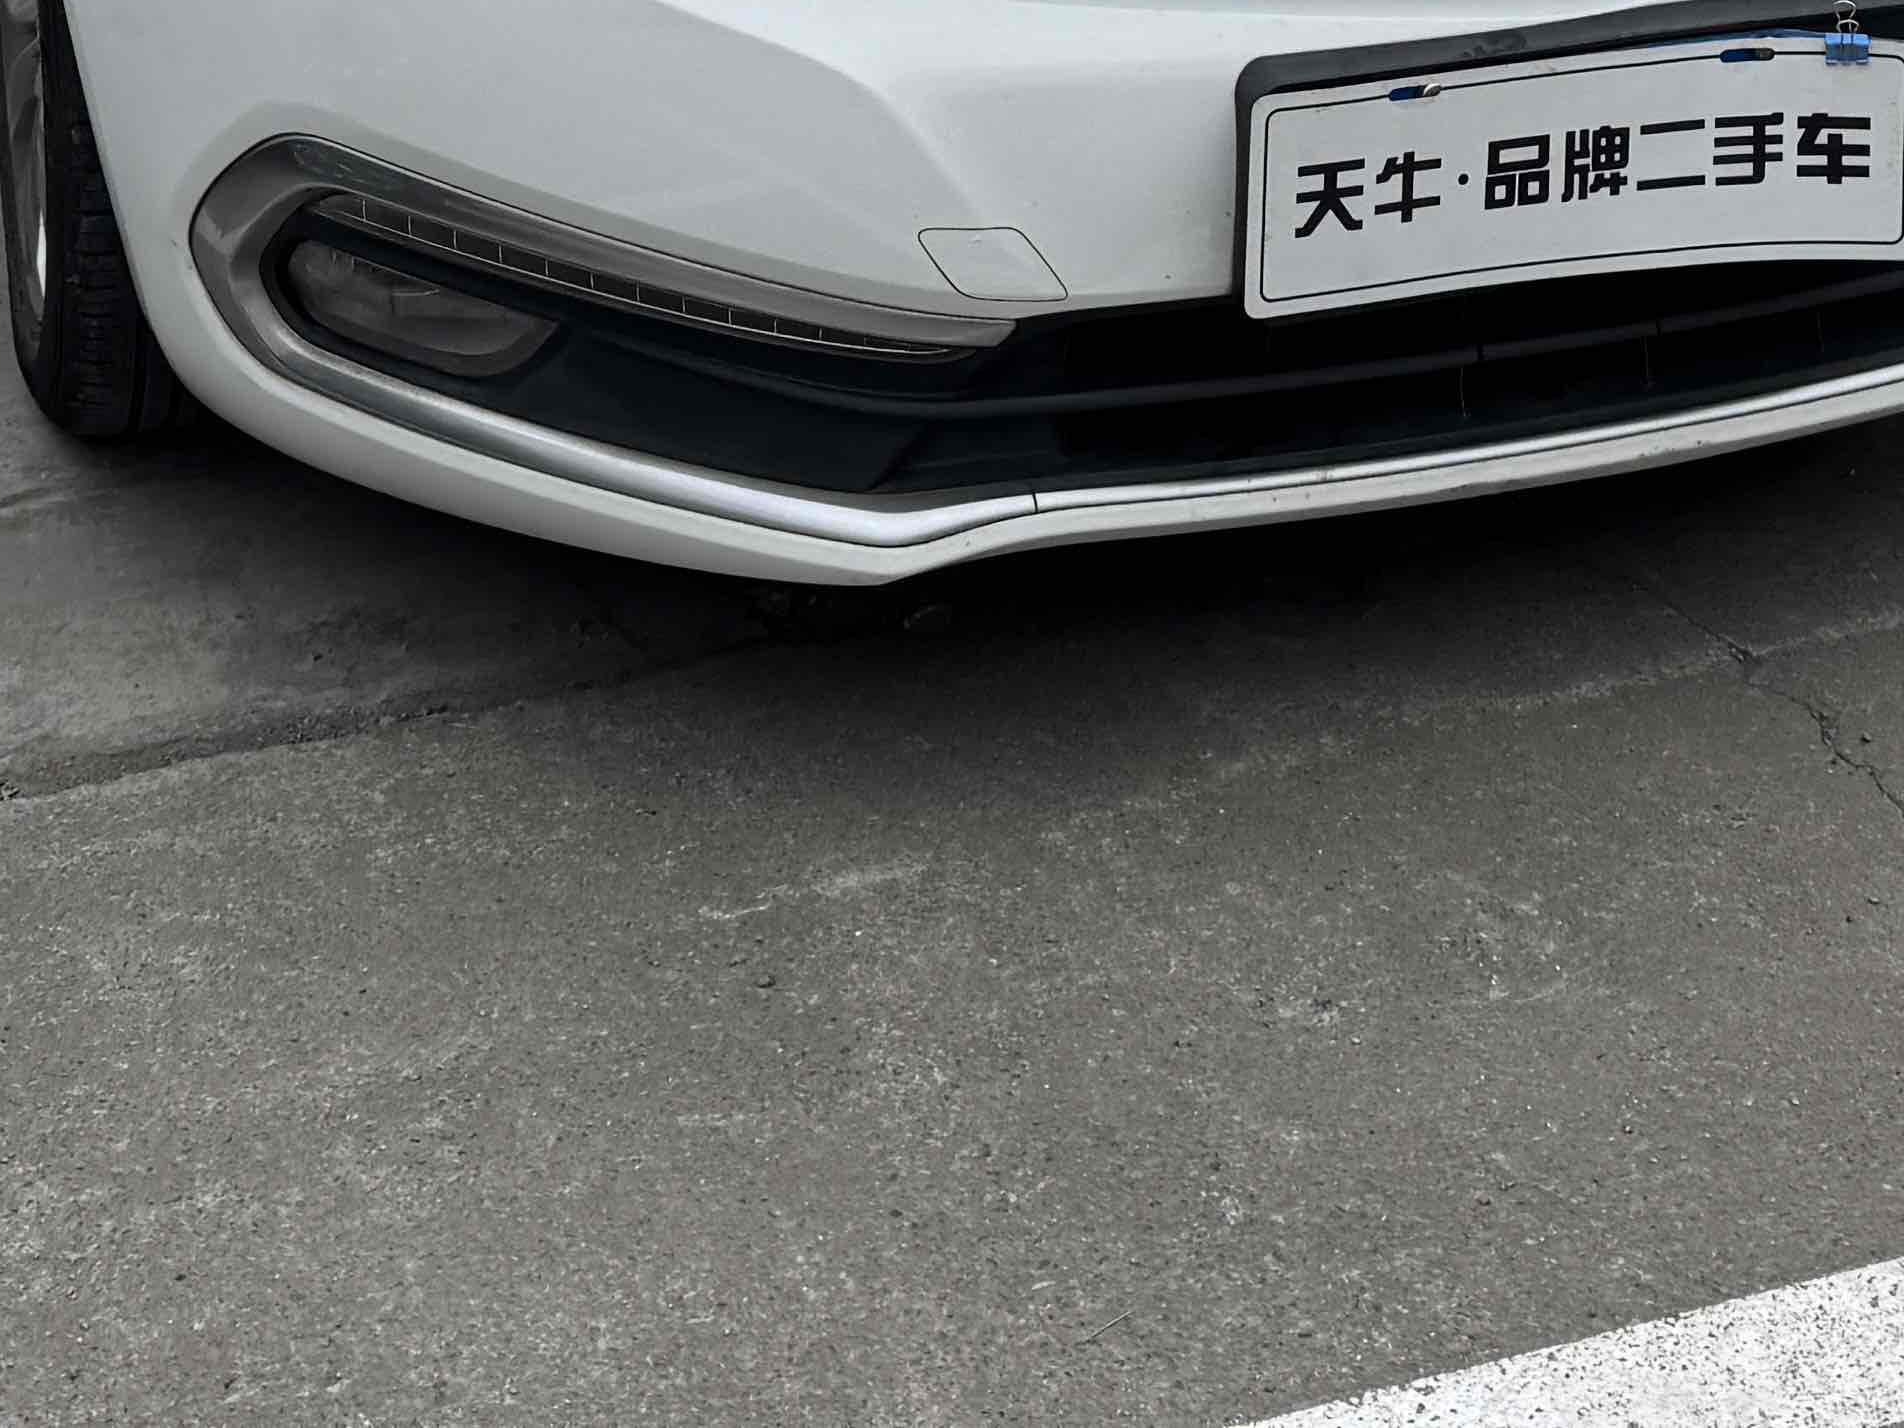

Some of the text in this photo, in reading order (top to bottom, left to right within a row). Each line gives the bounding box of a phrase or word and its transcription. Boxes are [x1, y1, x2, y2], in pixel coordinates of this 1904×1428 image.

[1296, 111, 1872, 238] 天牛·品牌二手车
